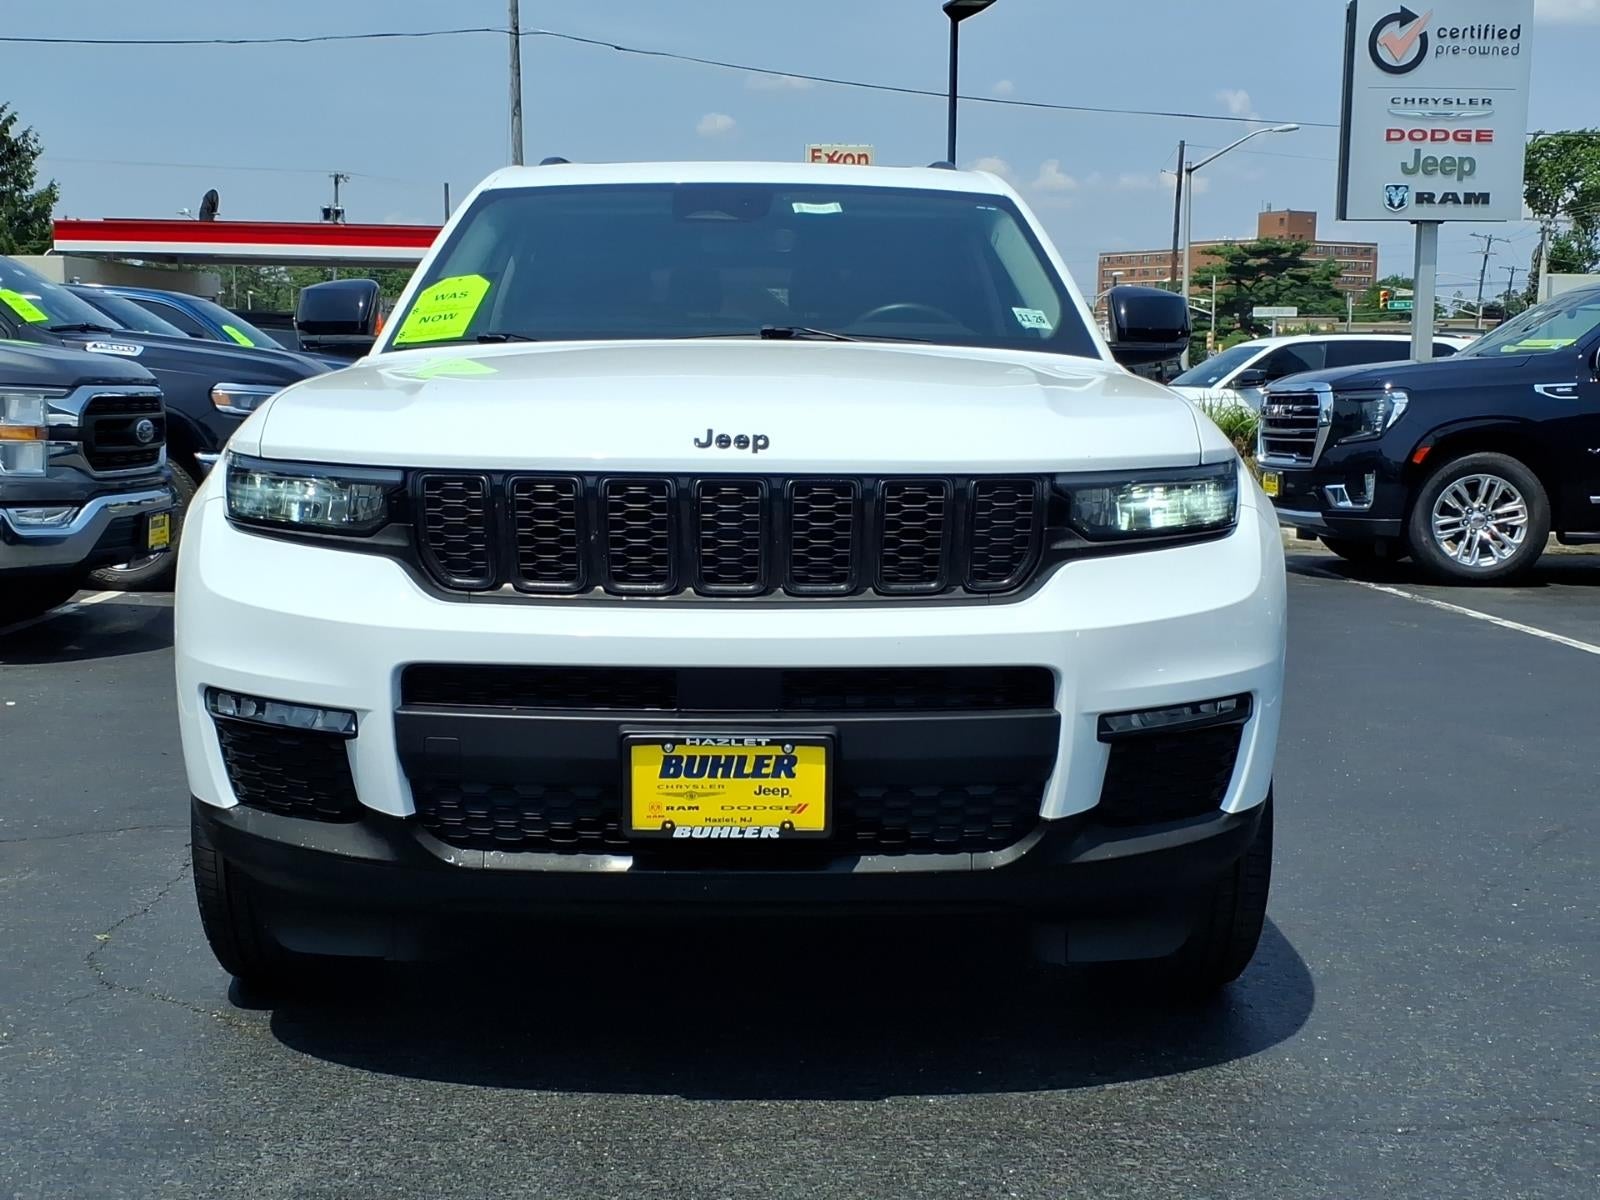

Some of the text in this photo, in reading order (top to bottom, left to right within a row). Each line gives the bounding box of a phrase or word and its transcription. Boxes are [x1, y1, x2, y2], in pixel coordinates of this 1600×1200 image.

[1437, 24, 1521, 40] certified
[1435, 43, 1520, 58] pre-owned
[1391, 97, 1493, 106] CHRYSLER
[1386, 129, 1494, 142] DODGE
[1401, 149, 1477, 181] Jeep
[1415, 192, 1490, 205] RAM
[435, 291, 469, 301] WAS
[419, 313, 458, 324] NOW
[693, 428, 770, 453] Jeep
[686, 738, 771, 746] HAZLET
[659, 755, 798, 779] BUHLER
[753, 785, 790, 798] Jeep
[673, 827, 780, 839] BUHLER
